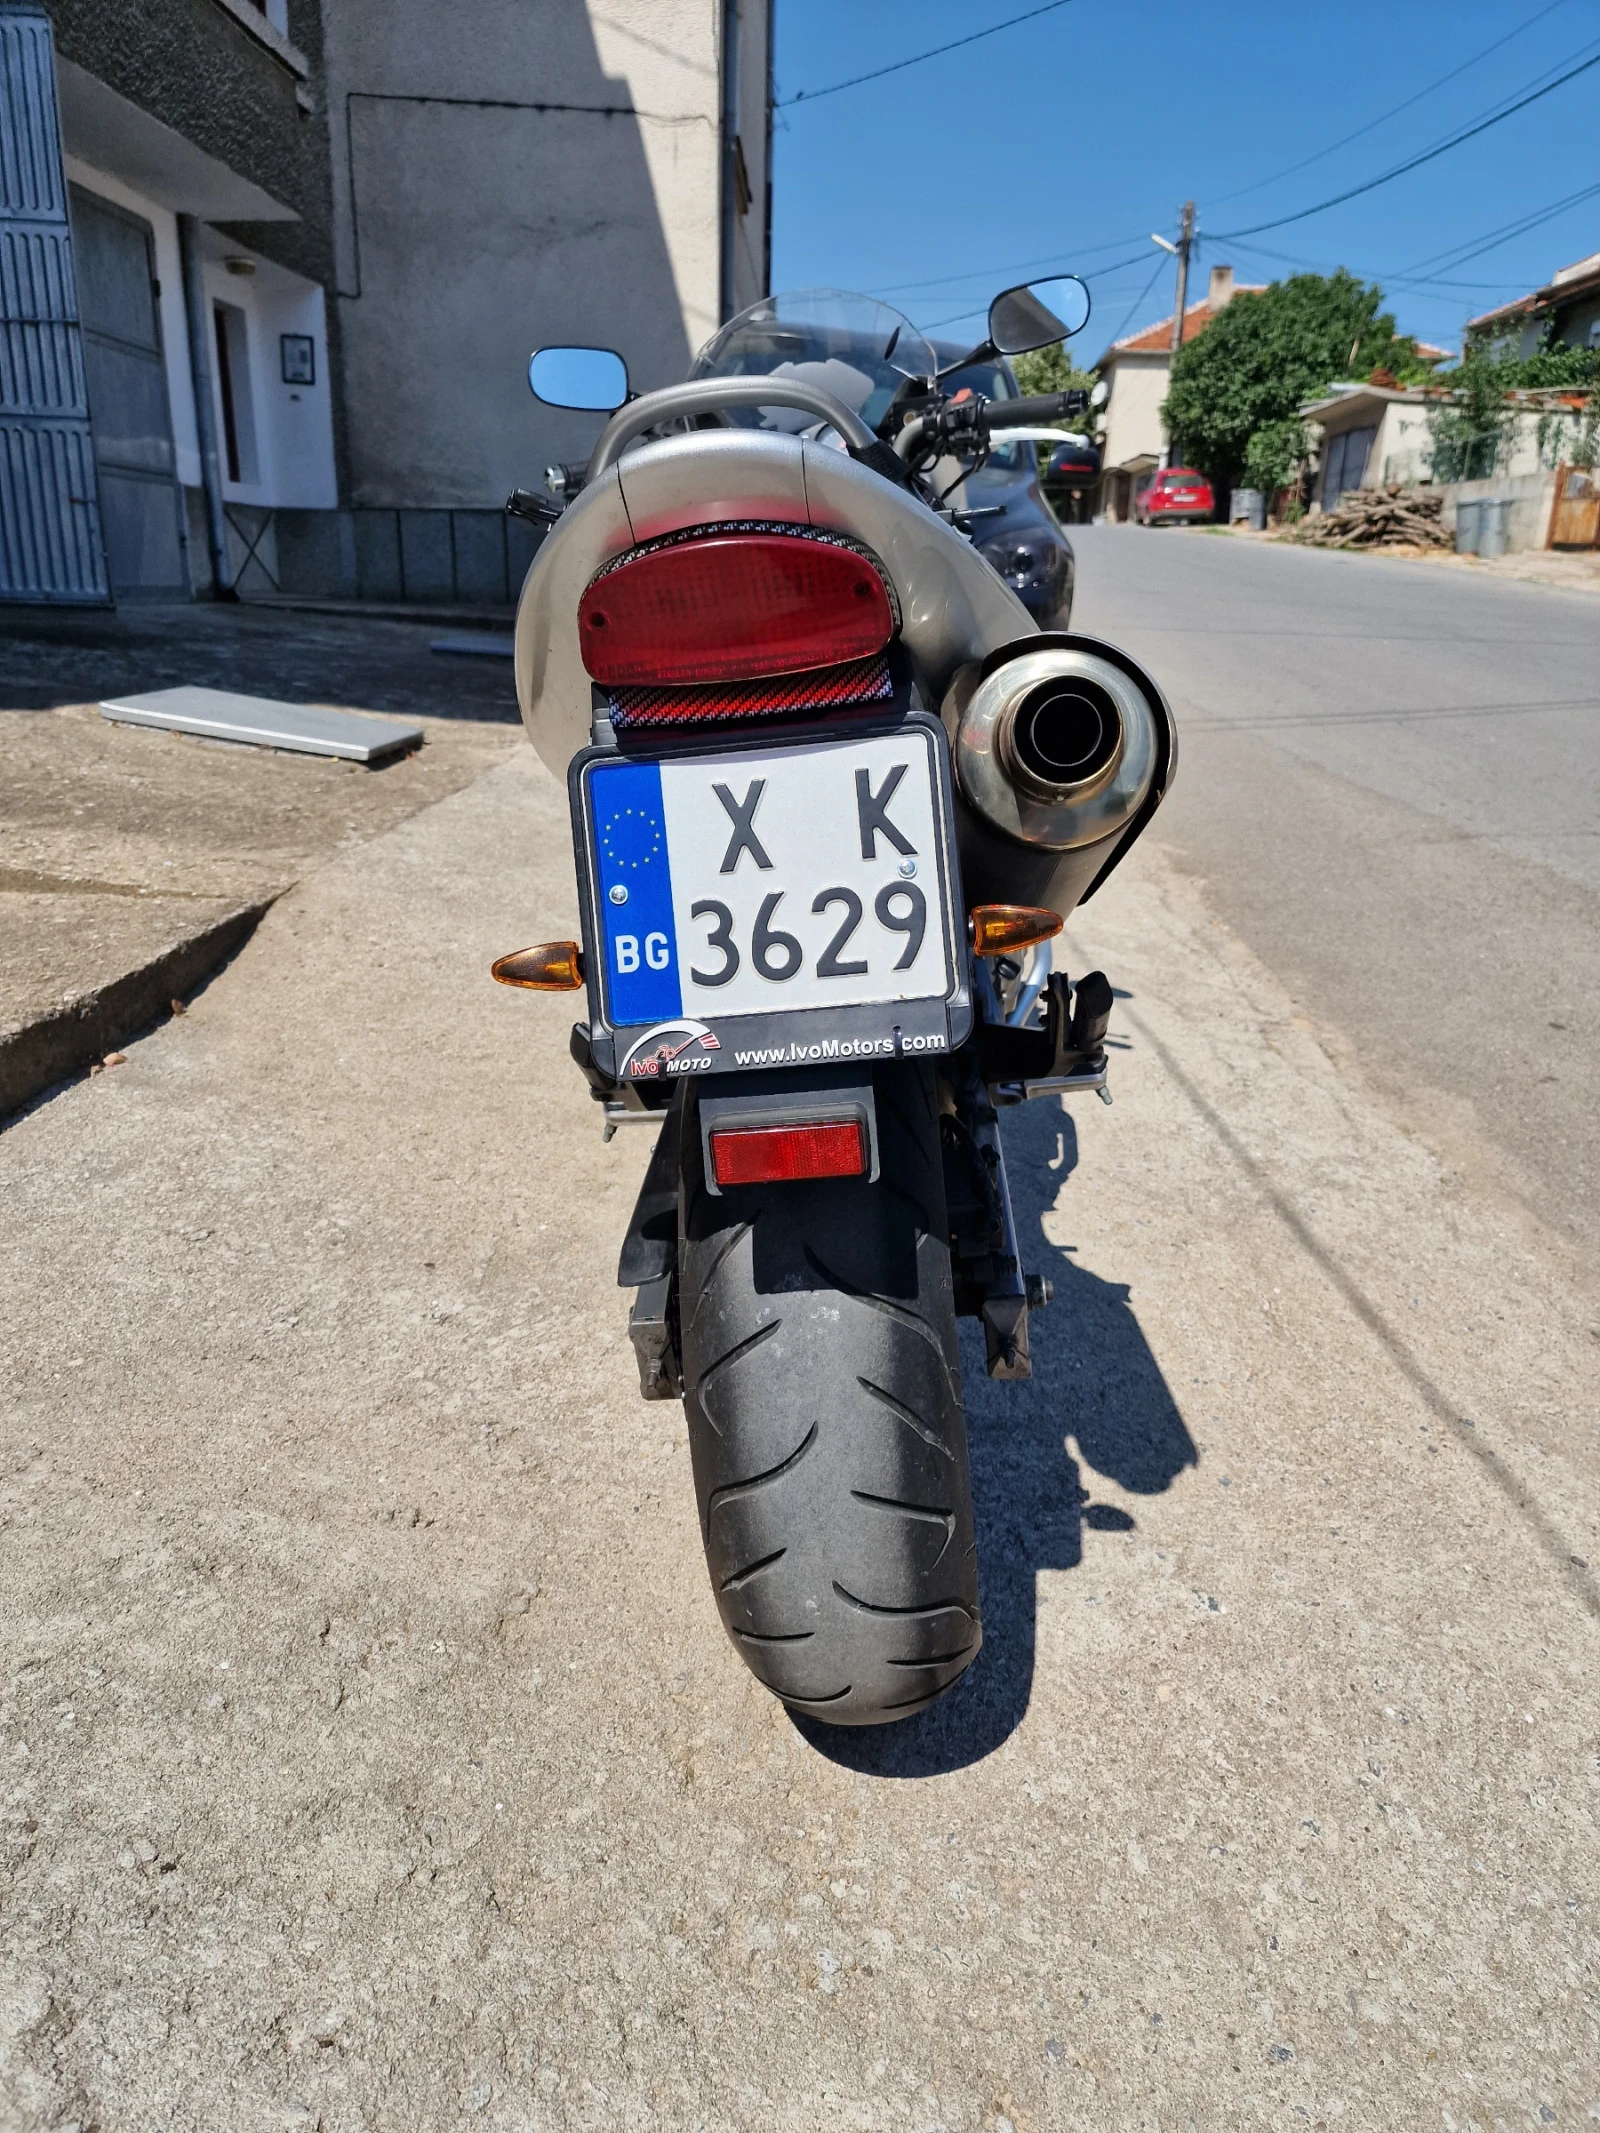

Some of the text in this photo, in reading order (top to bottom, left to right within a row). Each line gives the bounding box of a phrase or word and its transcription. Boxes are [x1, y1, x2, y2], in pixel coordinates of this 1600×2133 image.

[711, 763, 919, 875] X K
[615, 932, 669, 974] BG
[690, 880, 927, 987] 3629
[631, 1057, 712, 1076] Ivo MOTO
[734, 1032, 946, 1066] www.IvoMotorscom
